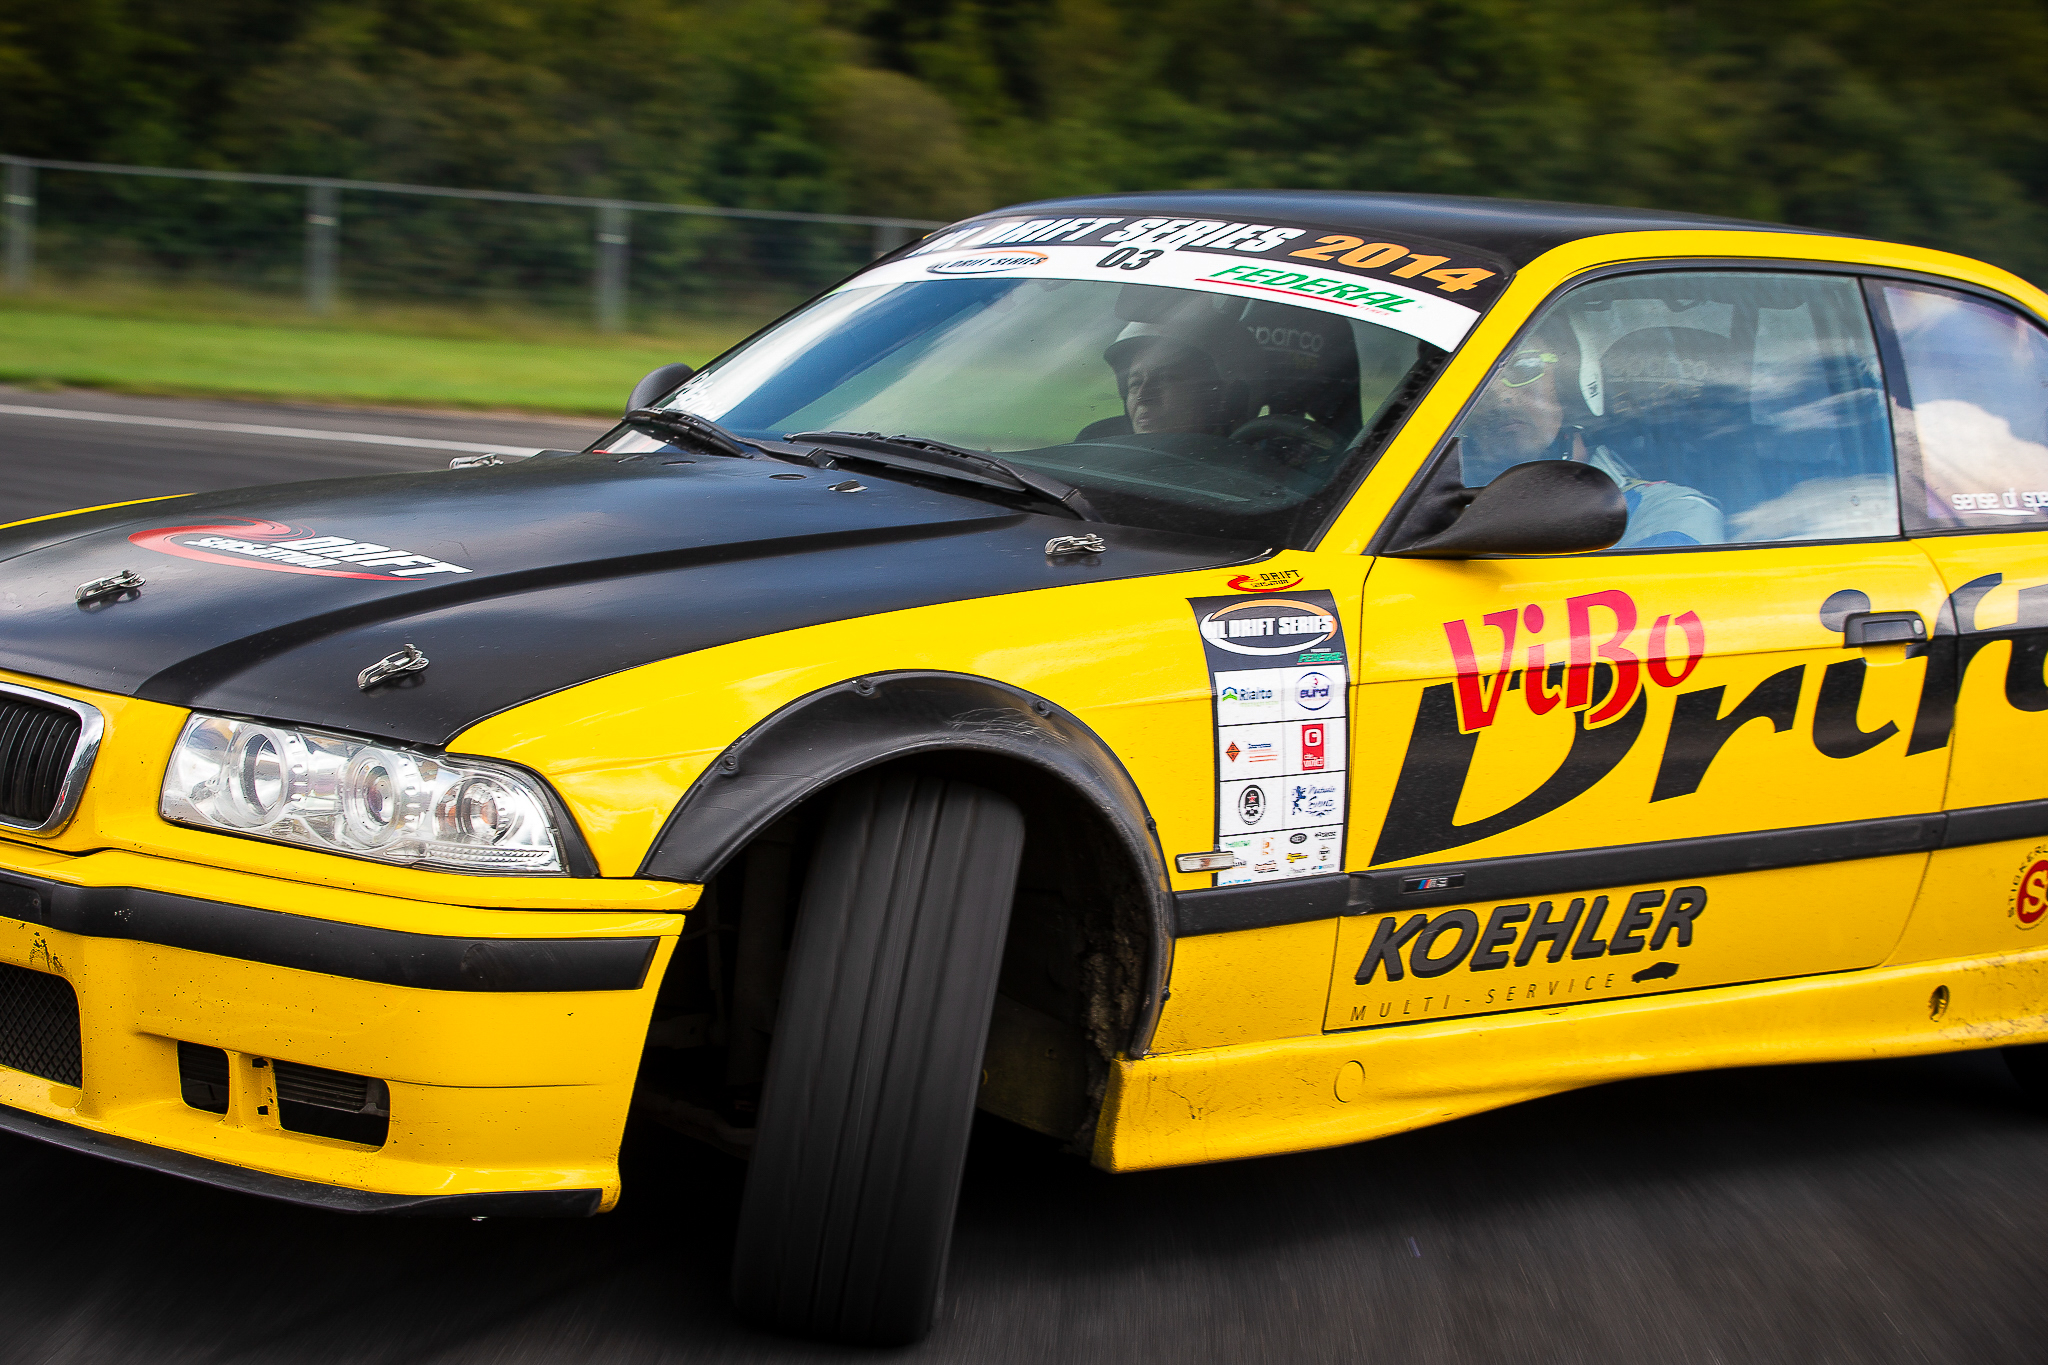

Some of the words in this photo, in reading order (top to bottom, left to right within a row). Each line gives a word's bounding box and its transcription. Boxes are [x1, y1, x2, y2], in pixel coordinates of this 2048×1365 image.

[960, 217, 1125, 248] DRIFT
[1100, 216, 1306, 253] SERIES
[1288, 235, 1496, 293] 2014
[1096, 246, 1165, 271] 03
[1209, 265, 1416, 314] FEDERAL
[1951, 493, 2000, 511] sense
[270, 535, 474, 578] DRIFT
[1259, 569, 1300, 581] DRIFT
[1228, 617, 1276, 638] DRIFT
[1278, 614, 1334, 635] SERIES
[1443, 589, 1706, 732] ViBo
[1354, 886, 1708, 985] KOEHLER
